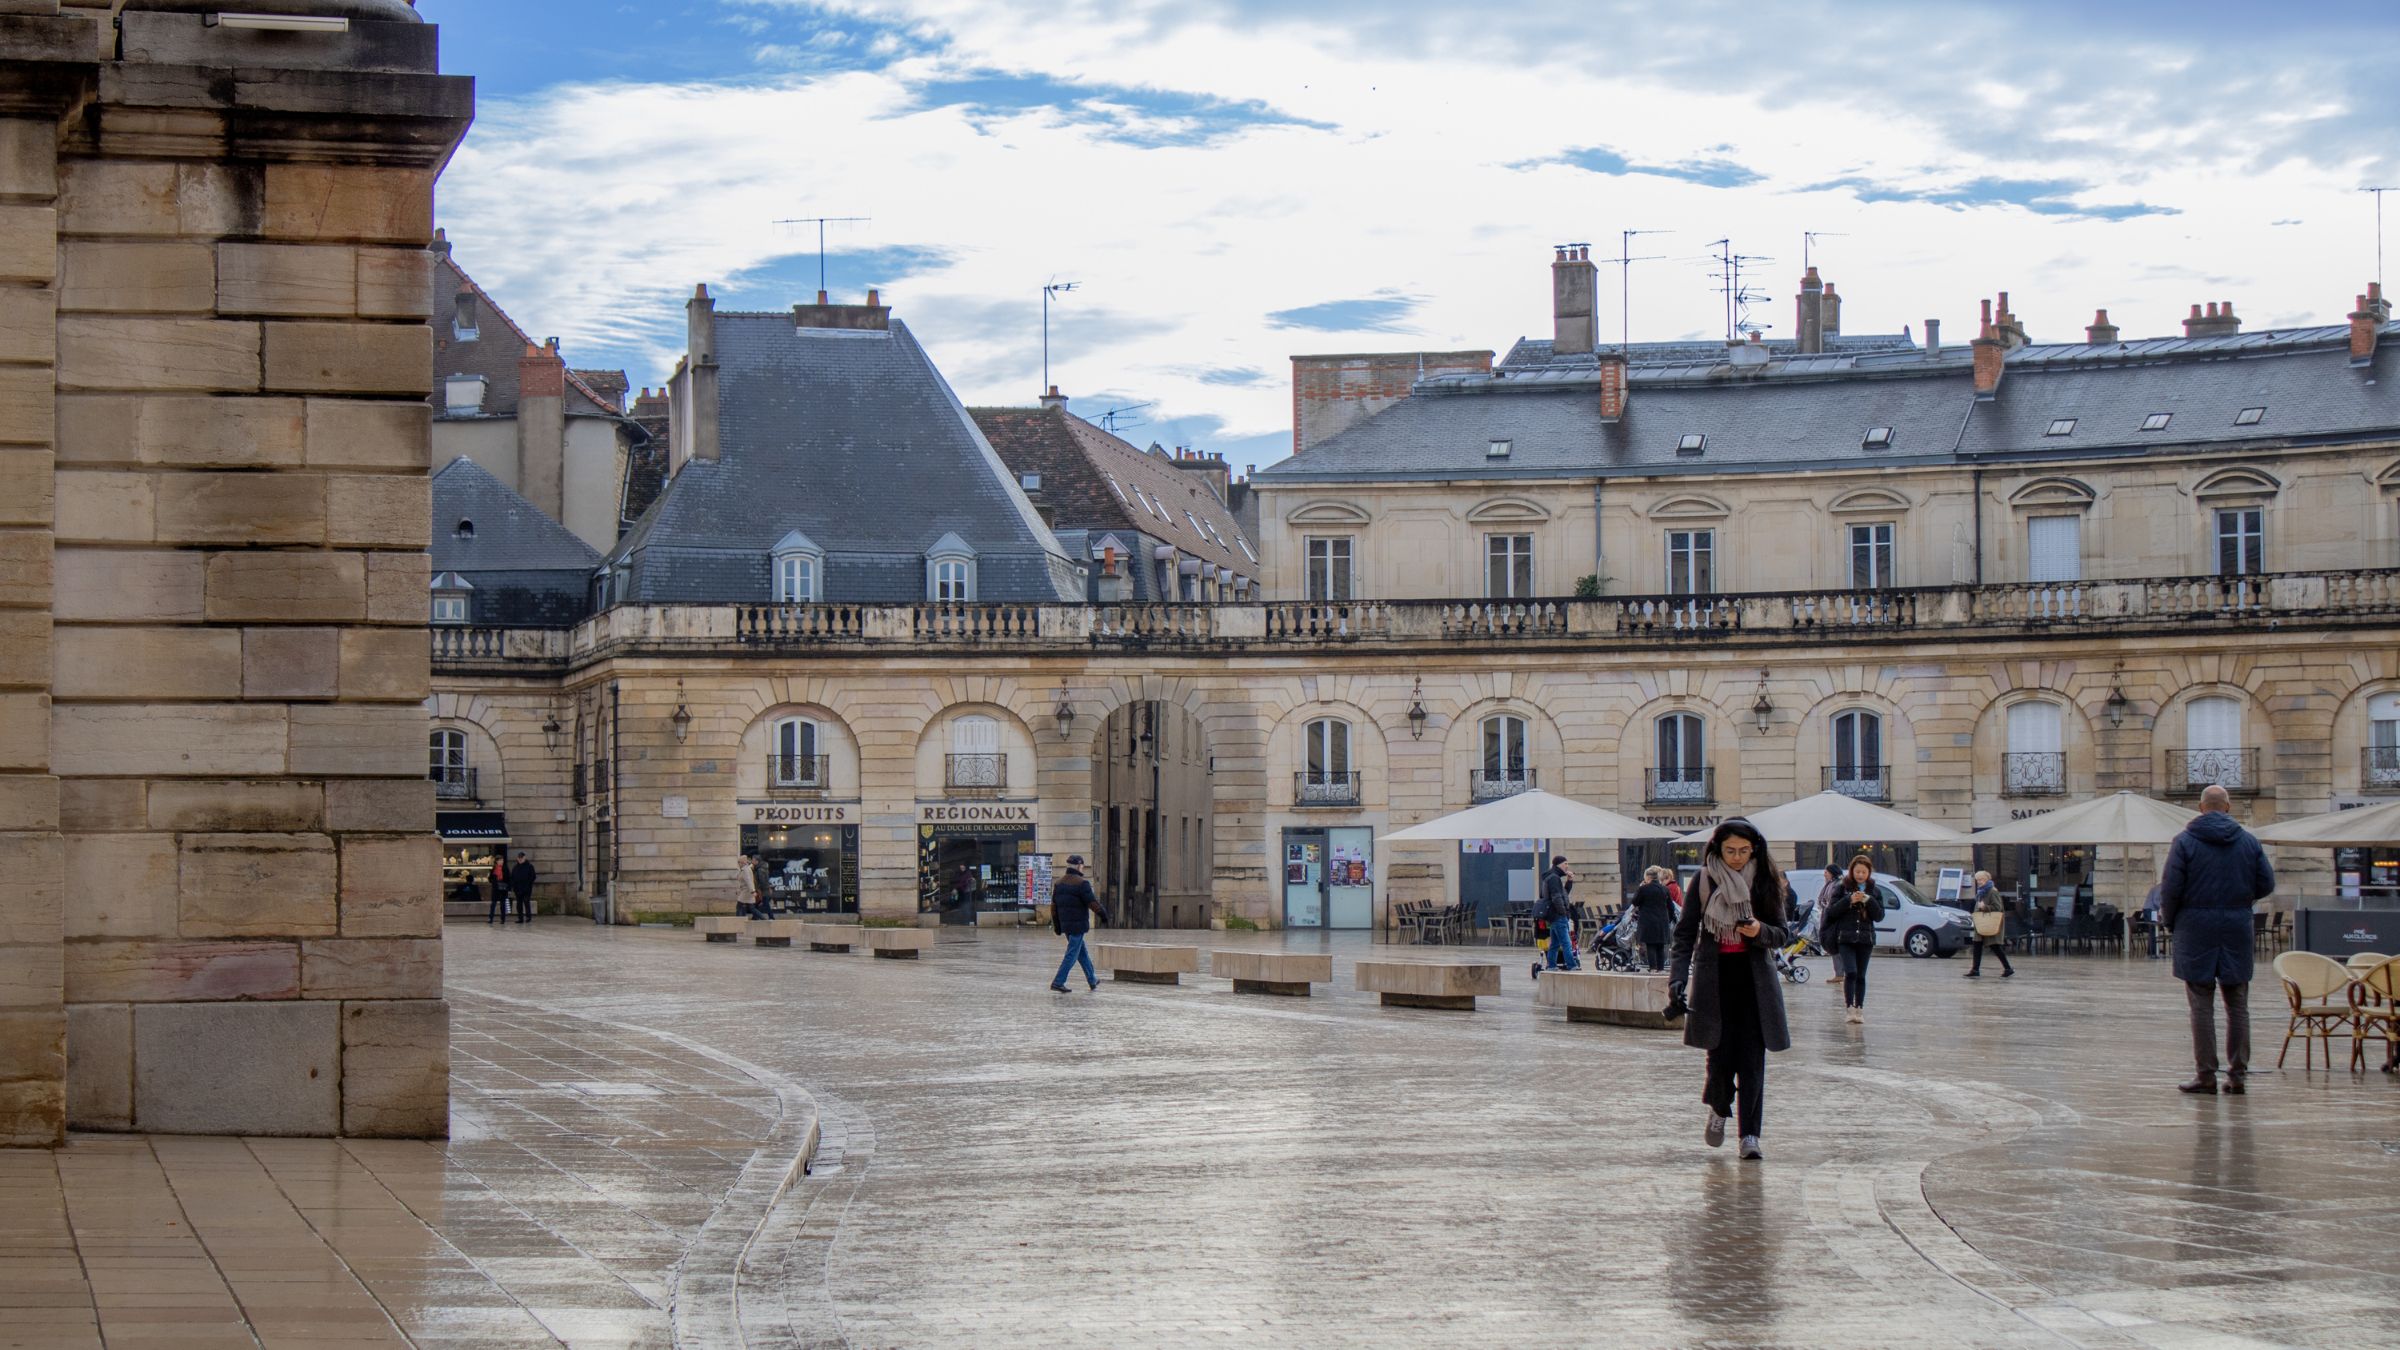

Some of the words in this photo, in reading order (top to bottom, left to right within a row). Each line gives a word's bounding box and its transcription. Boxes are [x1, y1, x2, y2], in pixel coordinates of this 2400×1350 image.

[754, 807, 845, 820] PRODUITS
[923, 807, 1031, 820] REGIONAUX
[935, 824, 946, 832] AU
[973, 824, 983, 832] DE
[984, 824, 1029, 832] BOURGOGNE
